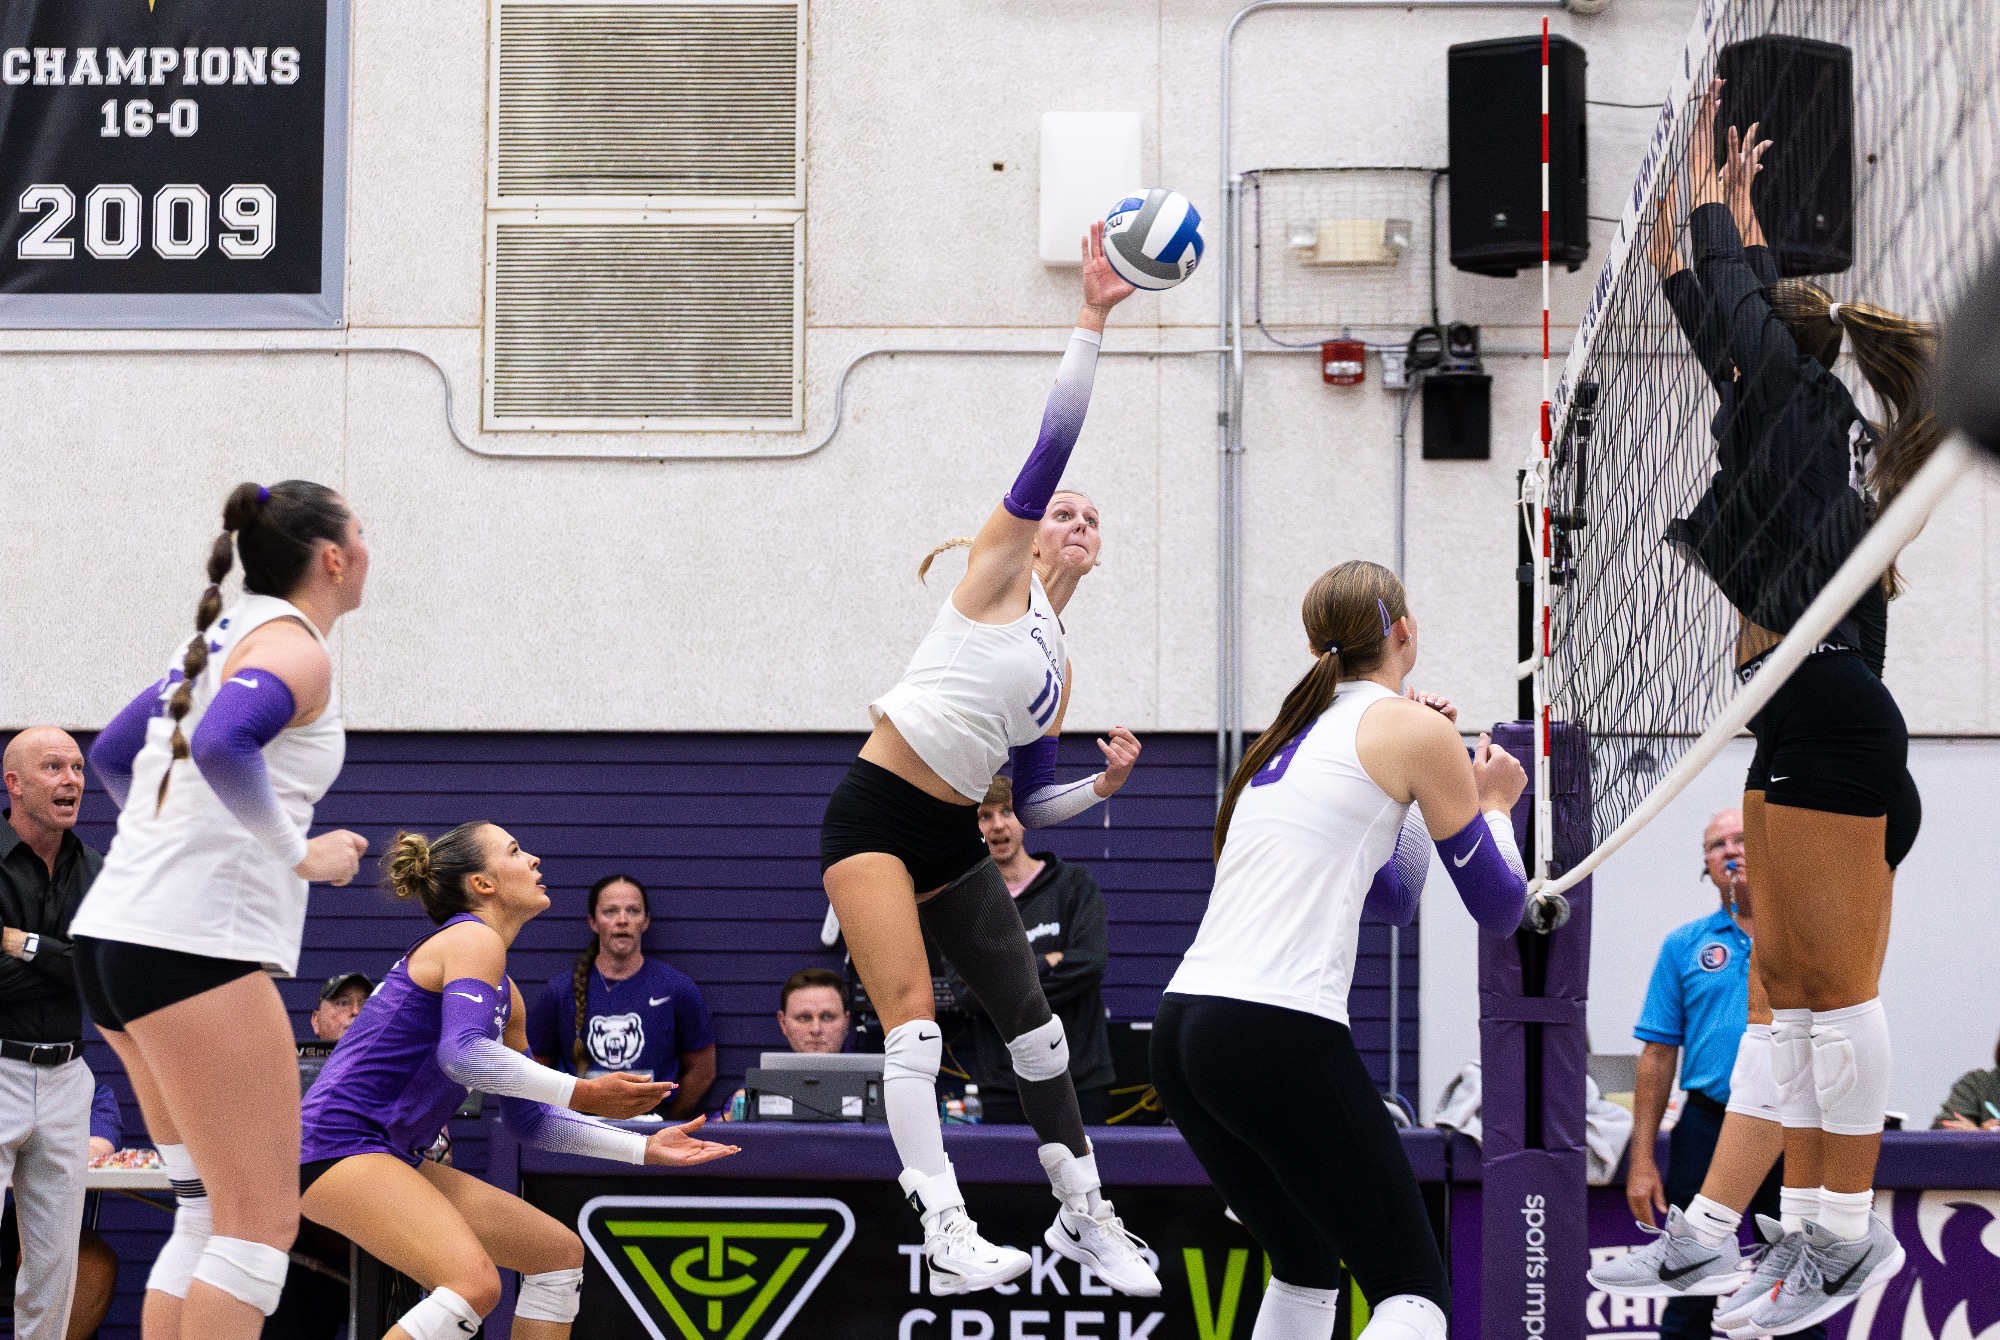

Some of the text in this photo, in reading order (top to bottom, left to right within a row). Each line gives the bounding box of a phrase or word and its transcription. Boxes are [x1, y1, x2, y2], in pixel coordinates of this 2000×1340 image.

[2, 47, 300, 85] CHAMPIONS
[100, 99, 199, 137] 16-0
[17, 184, 277, 259] 2009
[1521, 1194, 1549, 1278] sports
